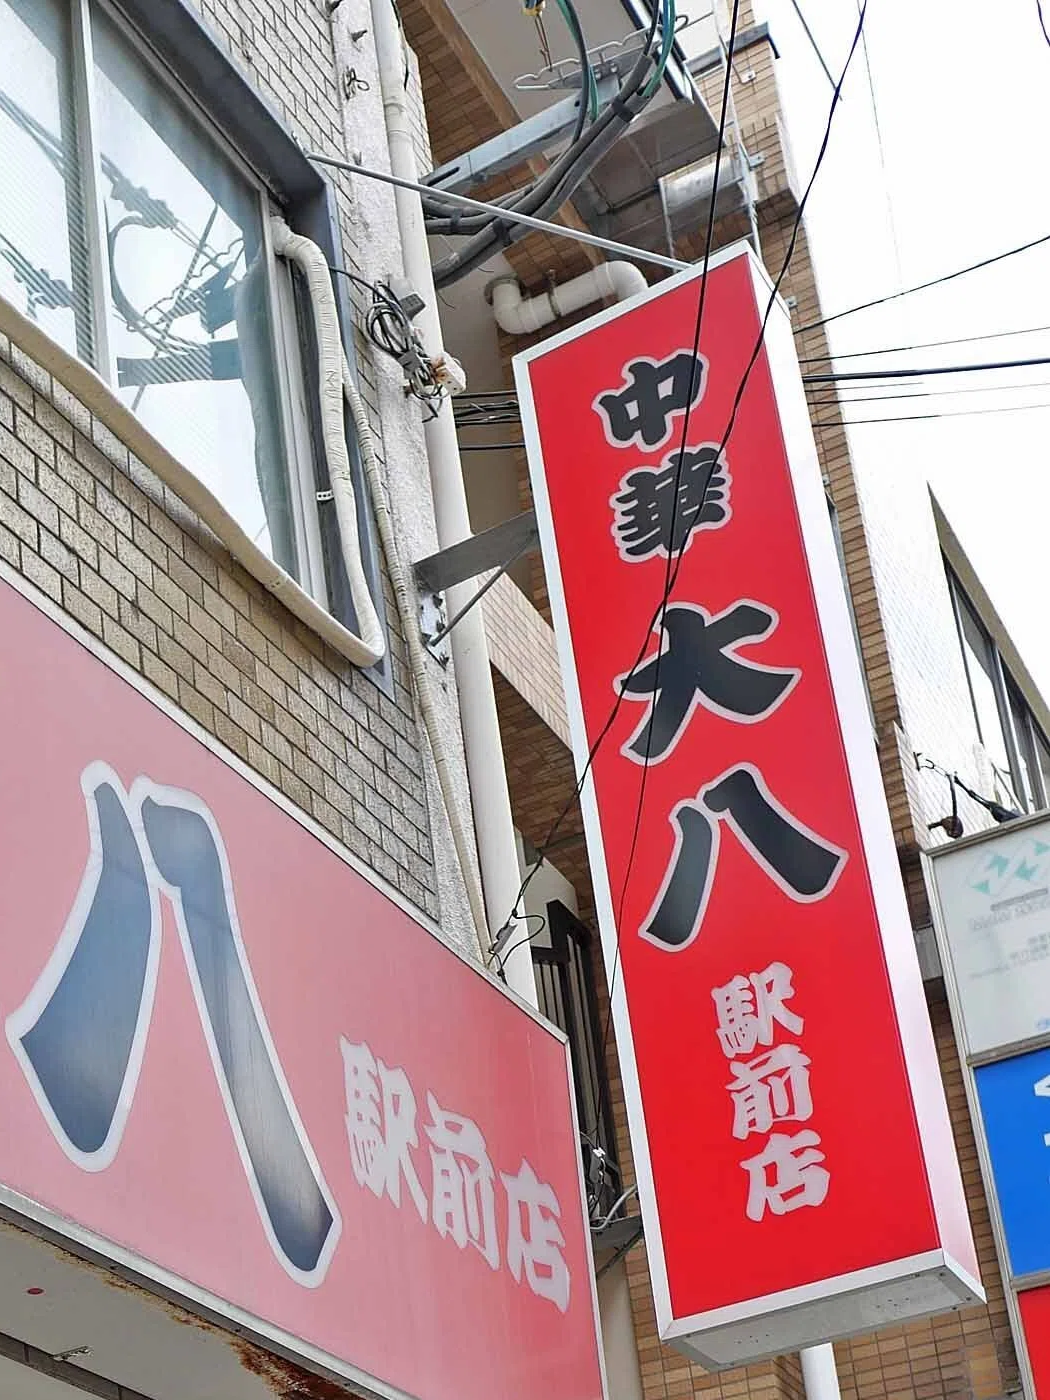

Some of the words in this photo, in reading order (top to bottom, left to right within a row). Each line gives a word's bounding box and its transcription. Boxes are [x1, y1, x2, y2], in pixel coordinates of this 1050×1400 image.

[593, 349, 733, 561] 中華
[614, 599, 848, 951] 大八
[340, 1034, 572, 1312] 駅前店
[711, 962, 830, 1222] 駅前店
